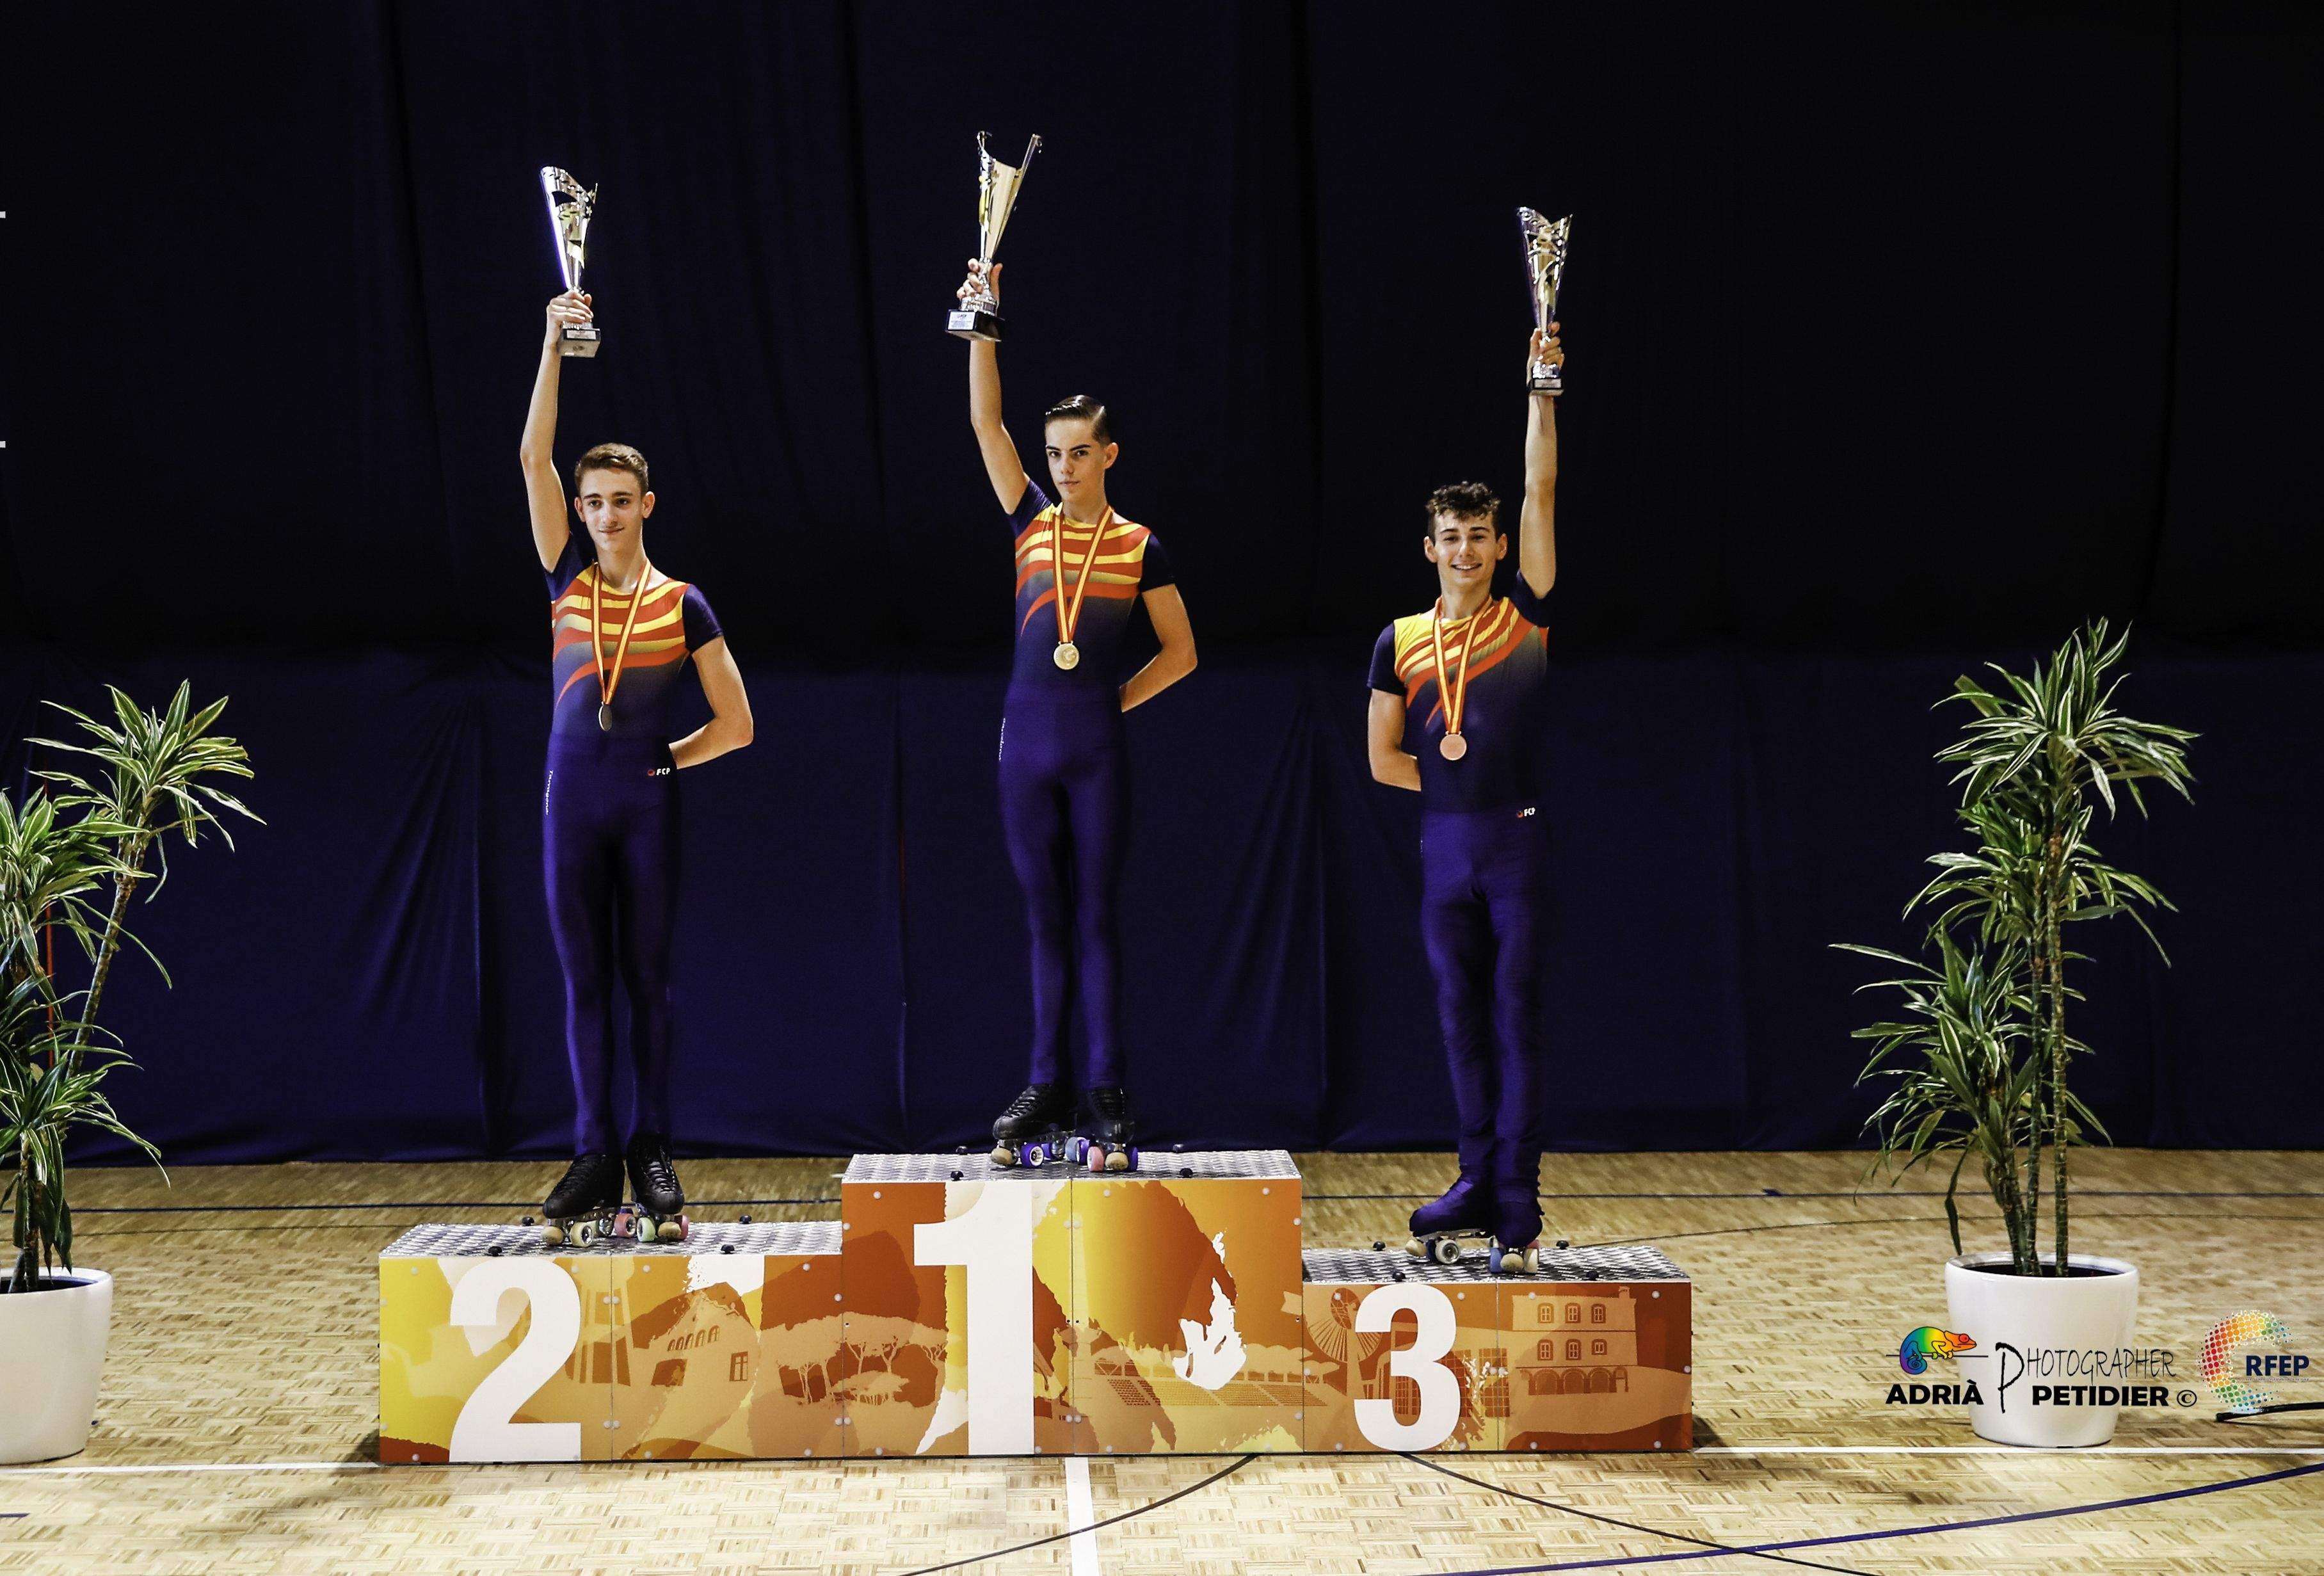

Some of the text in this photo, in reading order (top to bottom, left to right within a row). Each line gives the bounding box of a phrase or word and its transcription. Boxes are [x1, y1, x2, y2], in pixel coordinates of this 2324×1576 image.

[656, 768, 671, 776] FCP
[449, 1257, 581, 1463] 2
[914, 1180, 1034, 1455] 1
[1354, 1283, 1461, 1452] 3
